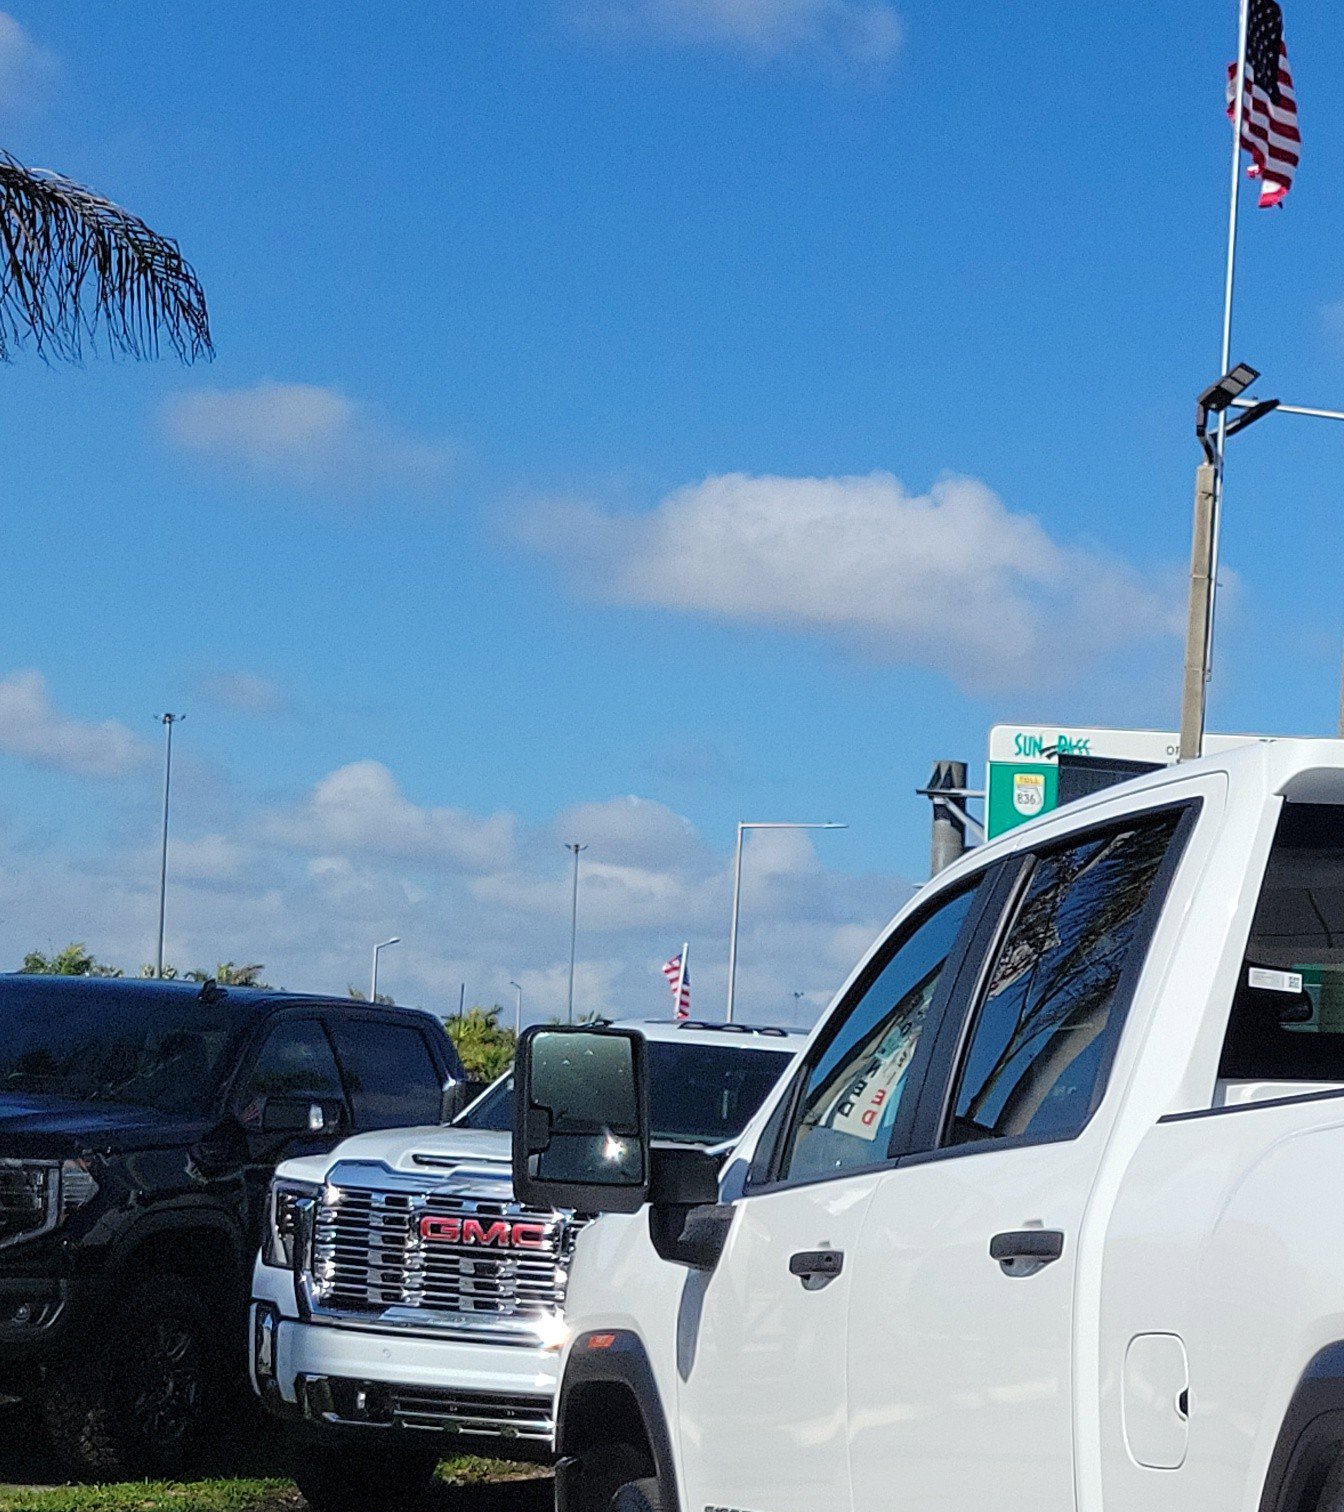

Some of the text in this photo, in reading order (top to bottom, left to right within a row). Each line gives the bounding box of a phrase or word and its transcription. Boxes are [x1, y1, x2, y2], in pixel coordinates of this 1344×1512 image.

[1014, 733, 1043, 758] SUN
[1017, 792, 1036, 805] 836
[420, 1215, 554, 1250] GMC
